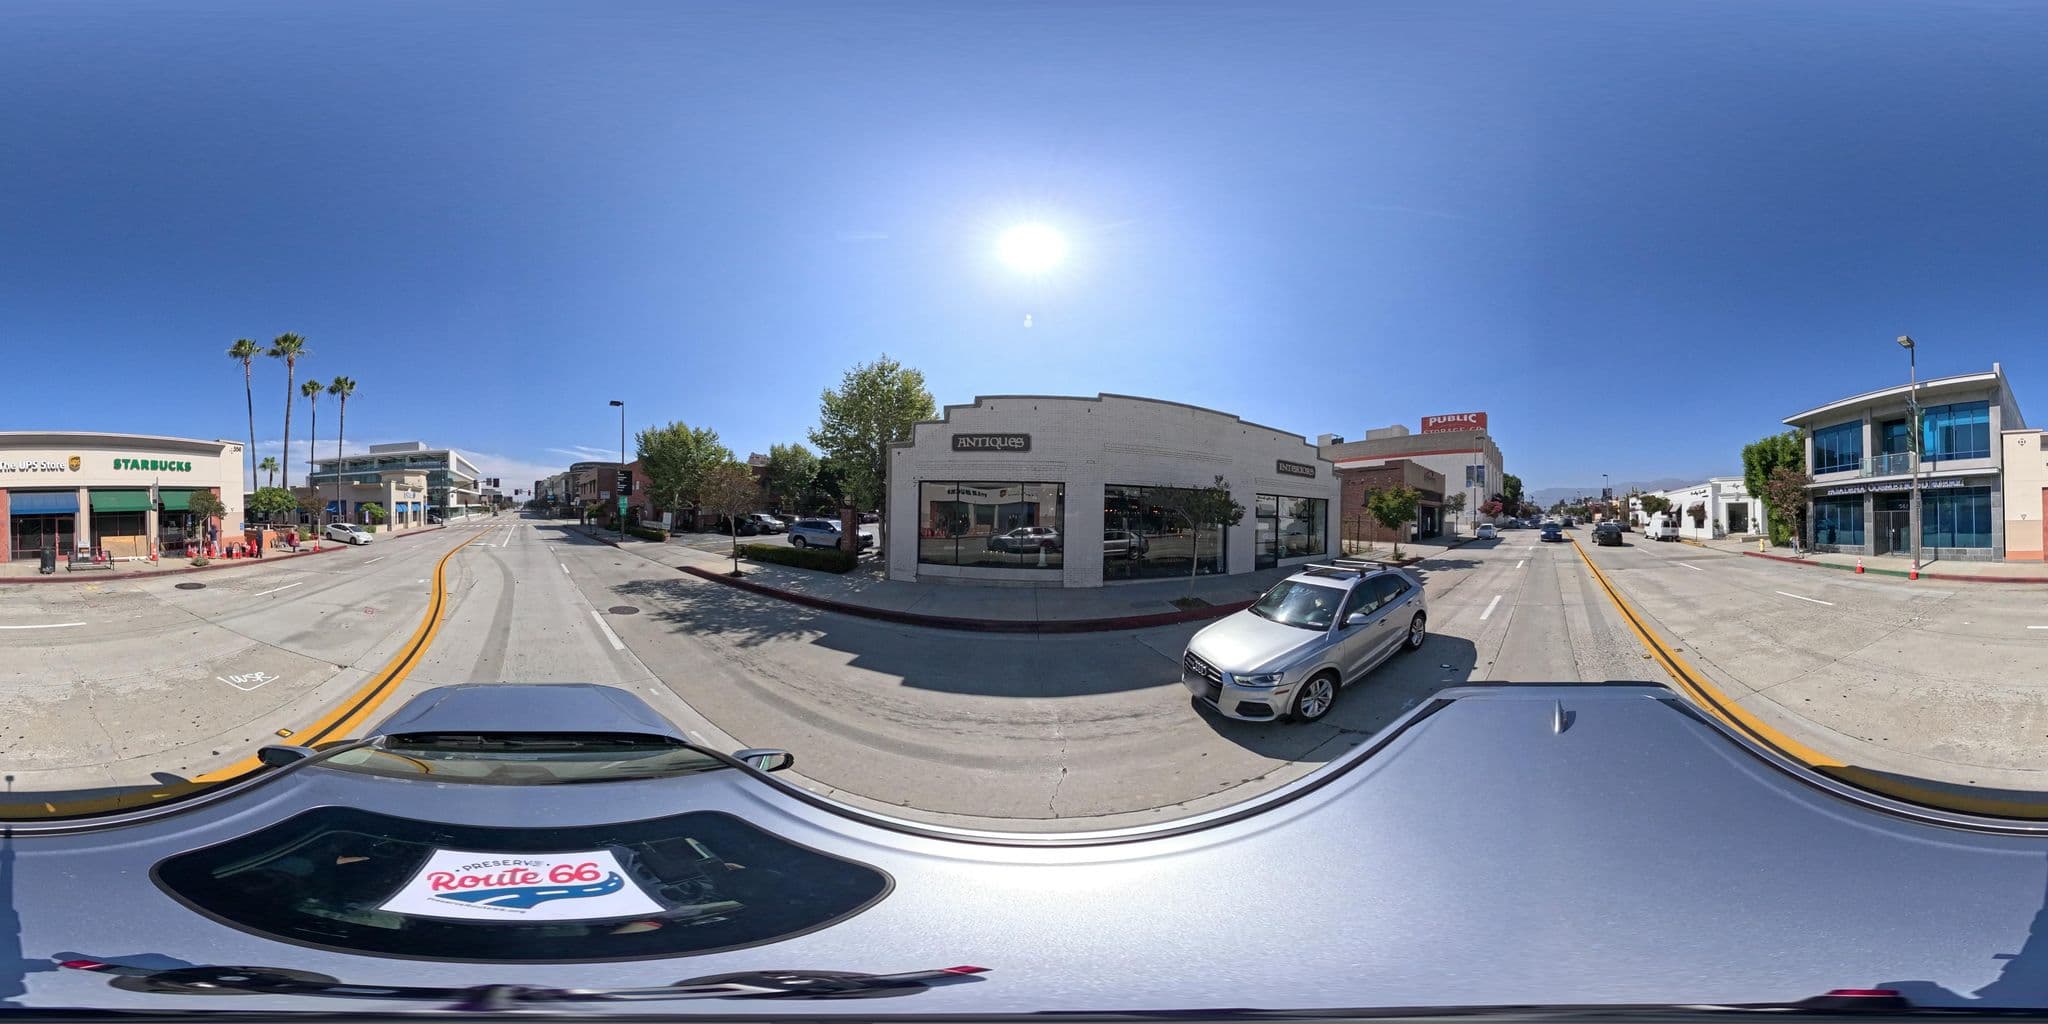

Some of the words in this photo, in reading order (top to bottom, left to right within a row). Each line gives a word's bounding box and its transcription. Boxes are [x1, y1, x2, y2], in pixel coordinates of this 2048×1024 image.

[1429, 413, 1477, 427] PUBLIC
[19, 459, 38, 472] UPS
[40, 459, 65, 472] Store
[113, 458, 192, 472] STARBUCKS
[426, 867, 544, 891] Route
[549, 862, 601, 884] 66
